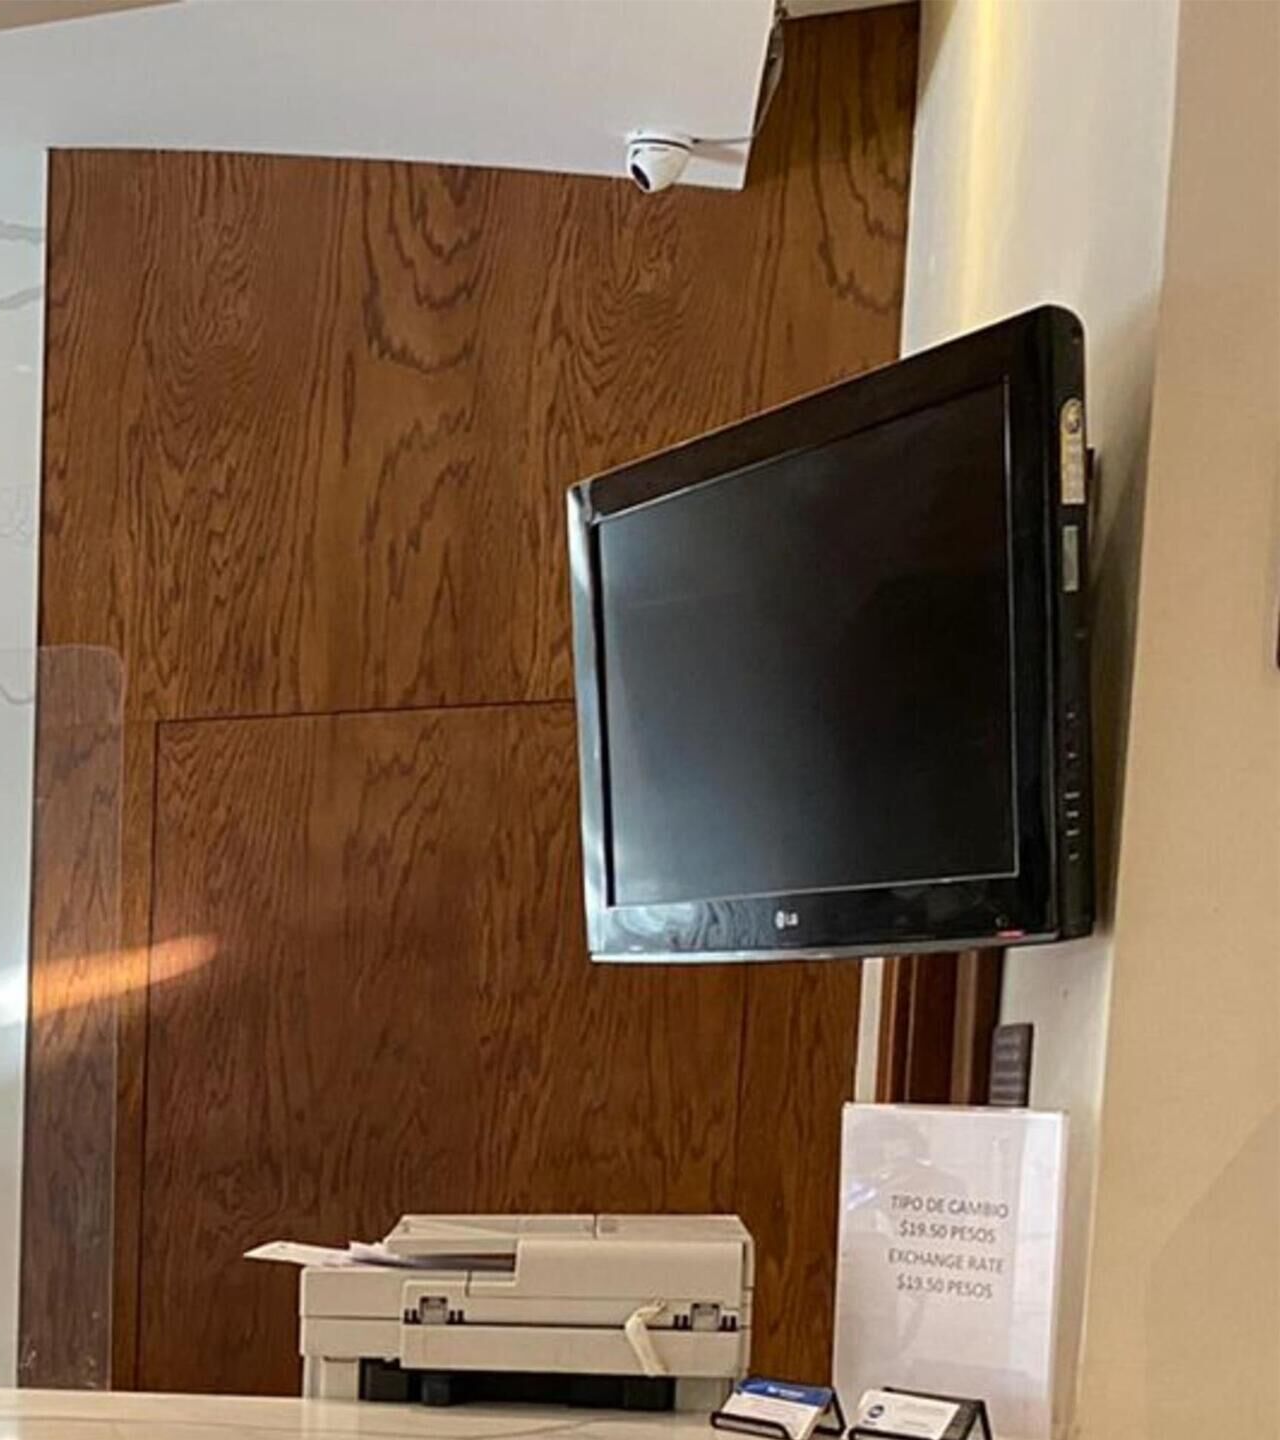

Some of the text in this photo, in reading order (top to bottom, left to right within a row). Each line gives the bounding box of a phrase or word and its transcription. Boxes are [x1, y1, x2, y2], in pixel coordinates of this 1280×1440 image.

[890, 1195, 1009, 1219] TIPO DE CAMBIO
[898, 1219, 997, 1244] $19.50 PESOS
[888, 1249, 1005, 1273] EXCHANGE RATE
[896, 1273, 993, 1299] $19.50 PESOS
